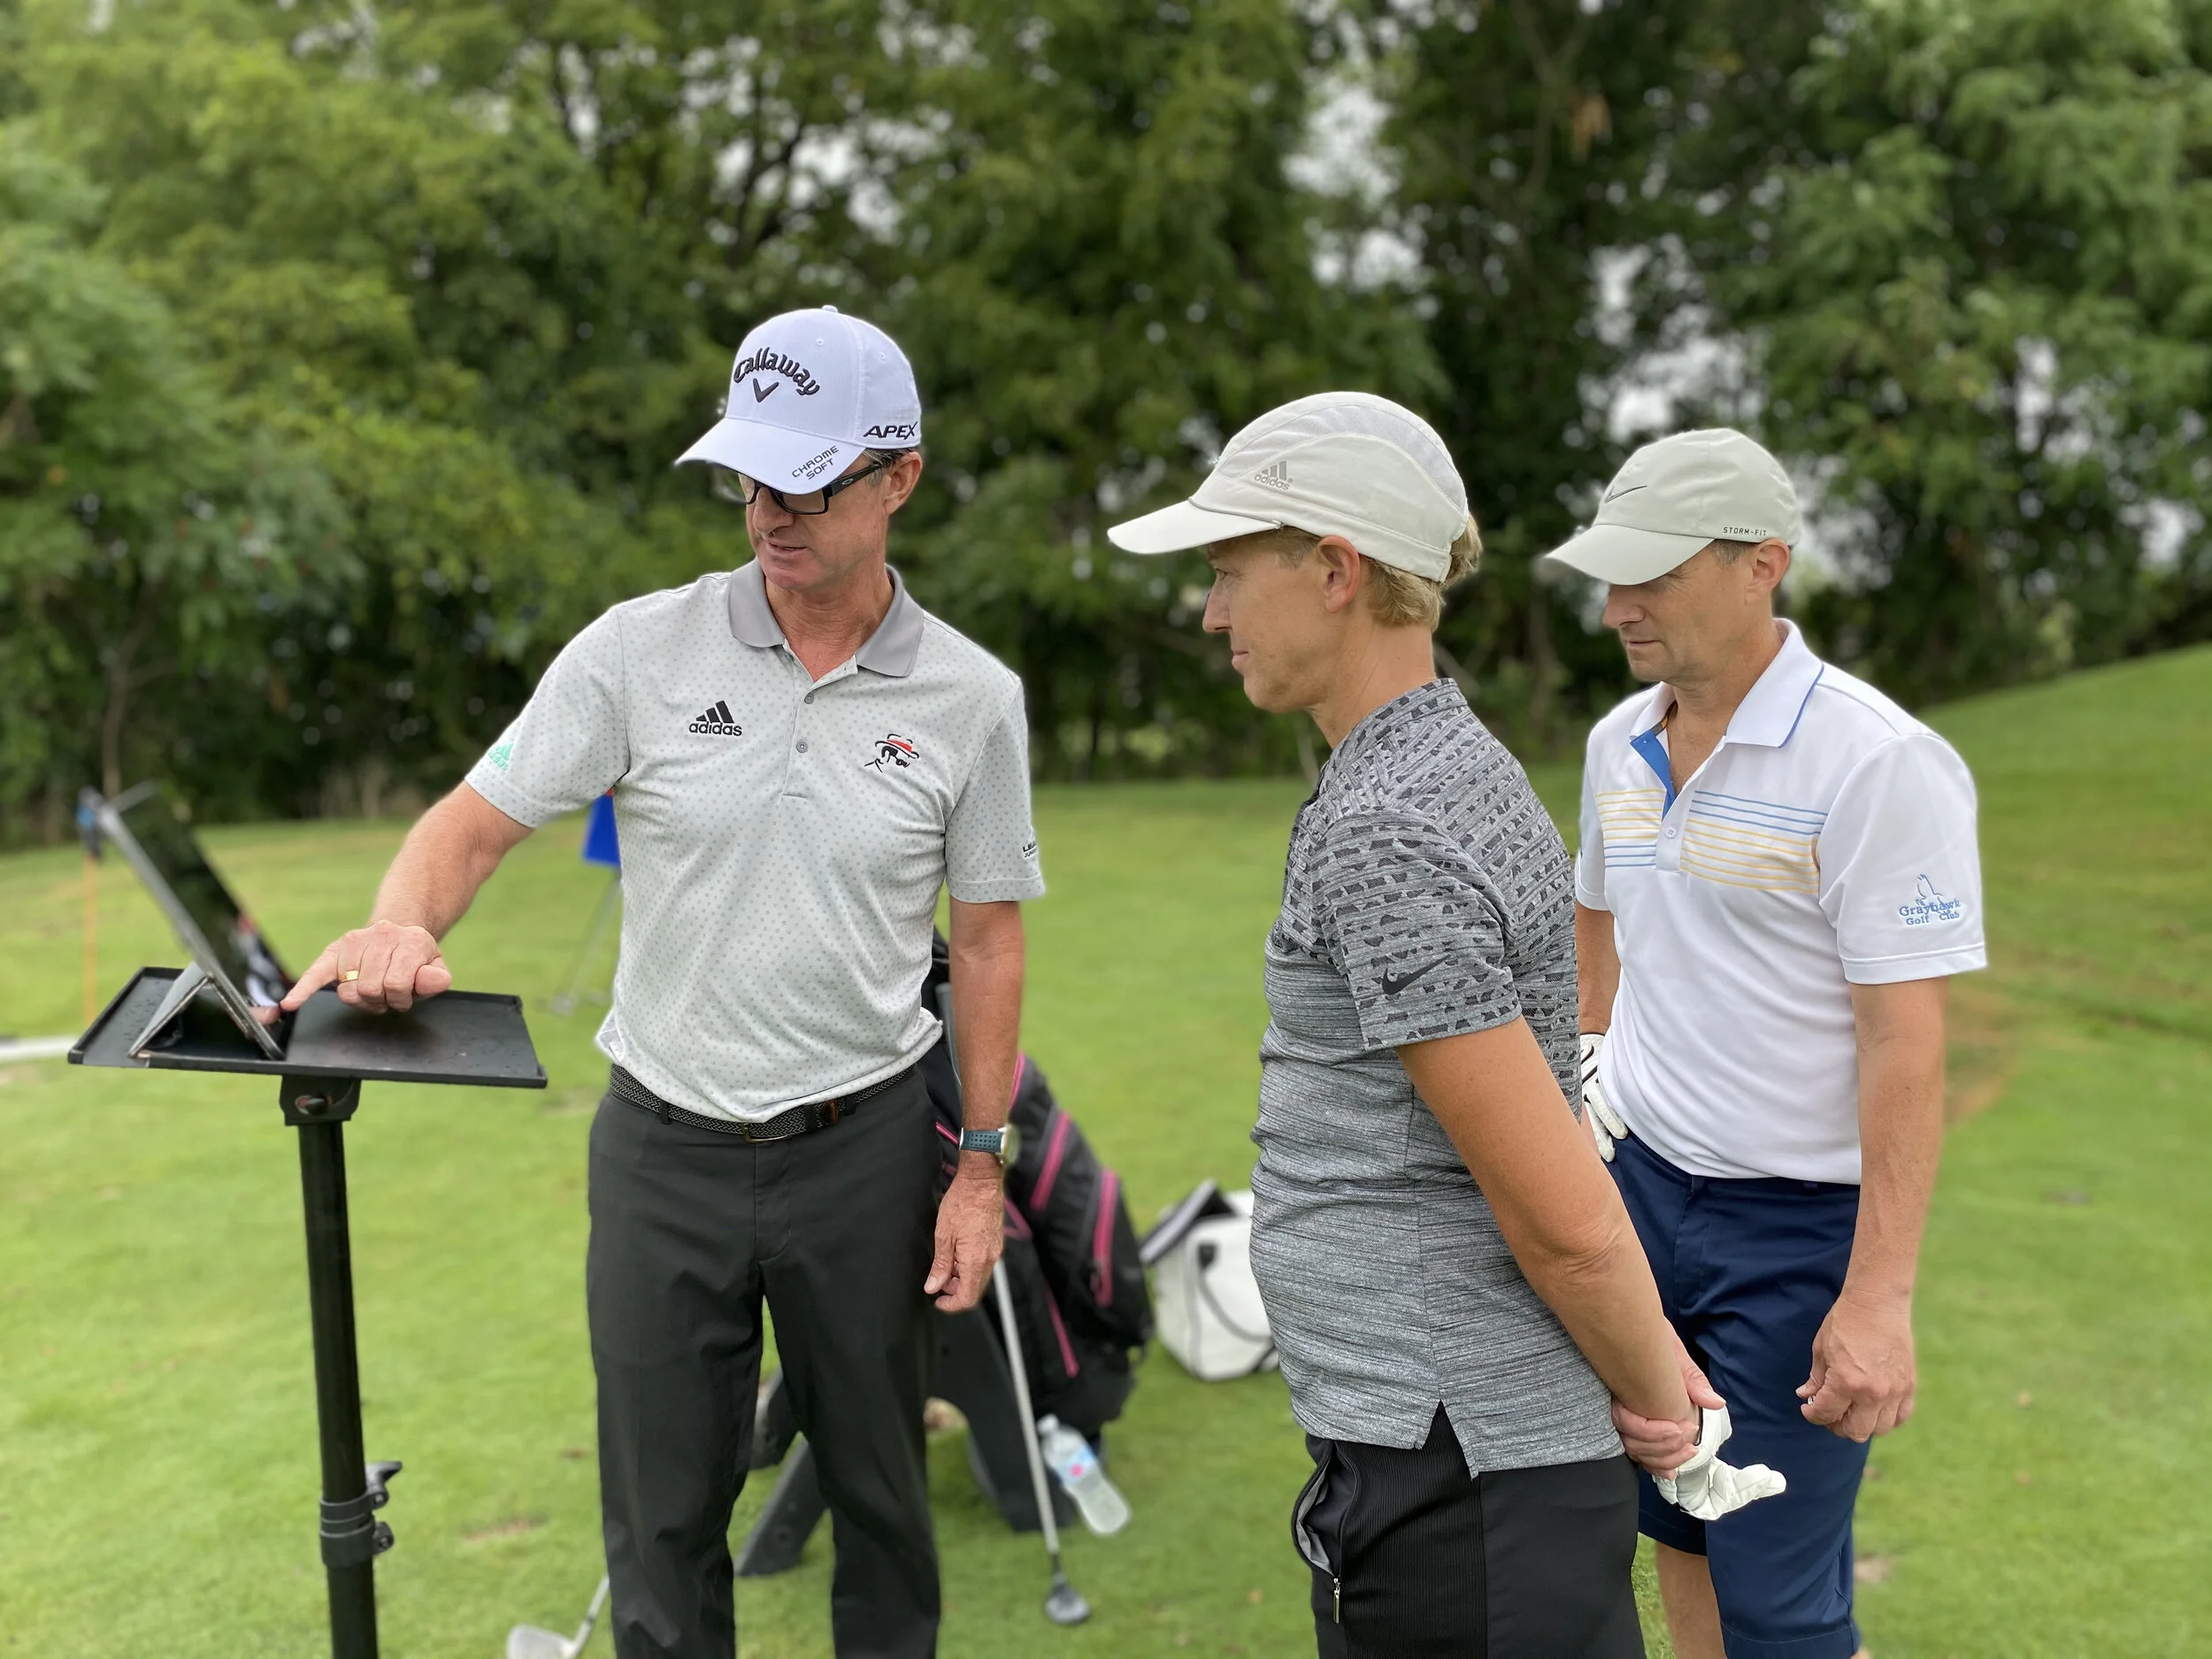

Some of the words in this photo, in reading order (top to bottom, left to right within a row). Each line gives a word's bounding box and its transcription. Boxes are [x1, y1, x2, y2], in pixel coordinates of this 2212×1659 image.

[733, 347, 820, 396] Callaway
[864, 422, 918, 440] APEX
[792, 446, 839, 478] CHROME
[806, 458, 835, 480] SOFT
[1255, 473, 1290, 491] adidas
[1723, 526, 1767, 536] STORM-FIT
[688, 721, 743, 737] adidas
[1899, 897, 1961, 917] Grayhawk
[1906, 915, 1930, 926] Golf
[1939, 911, 1960, 921] Club
